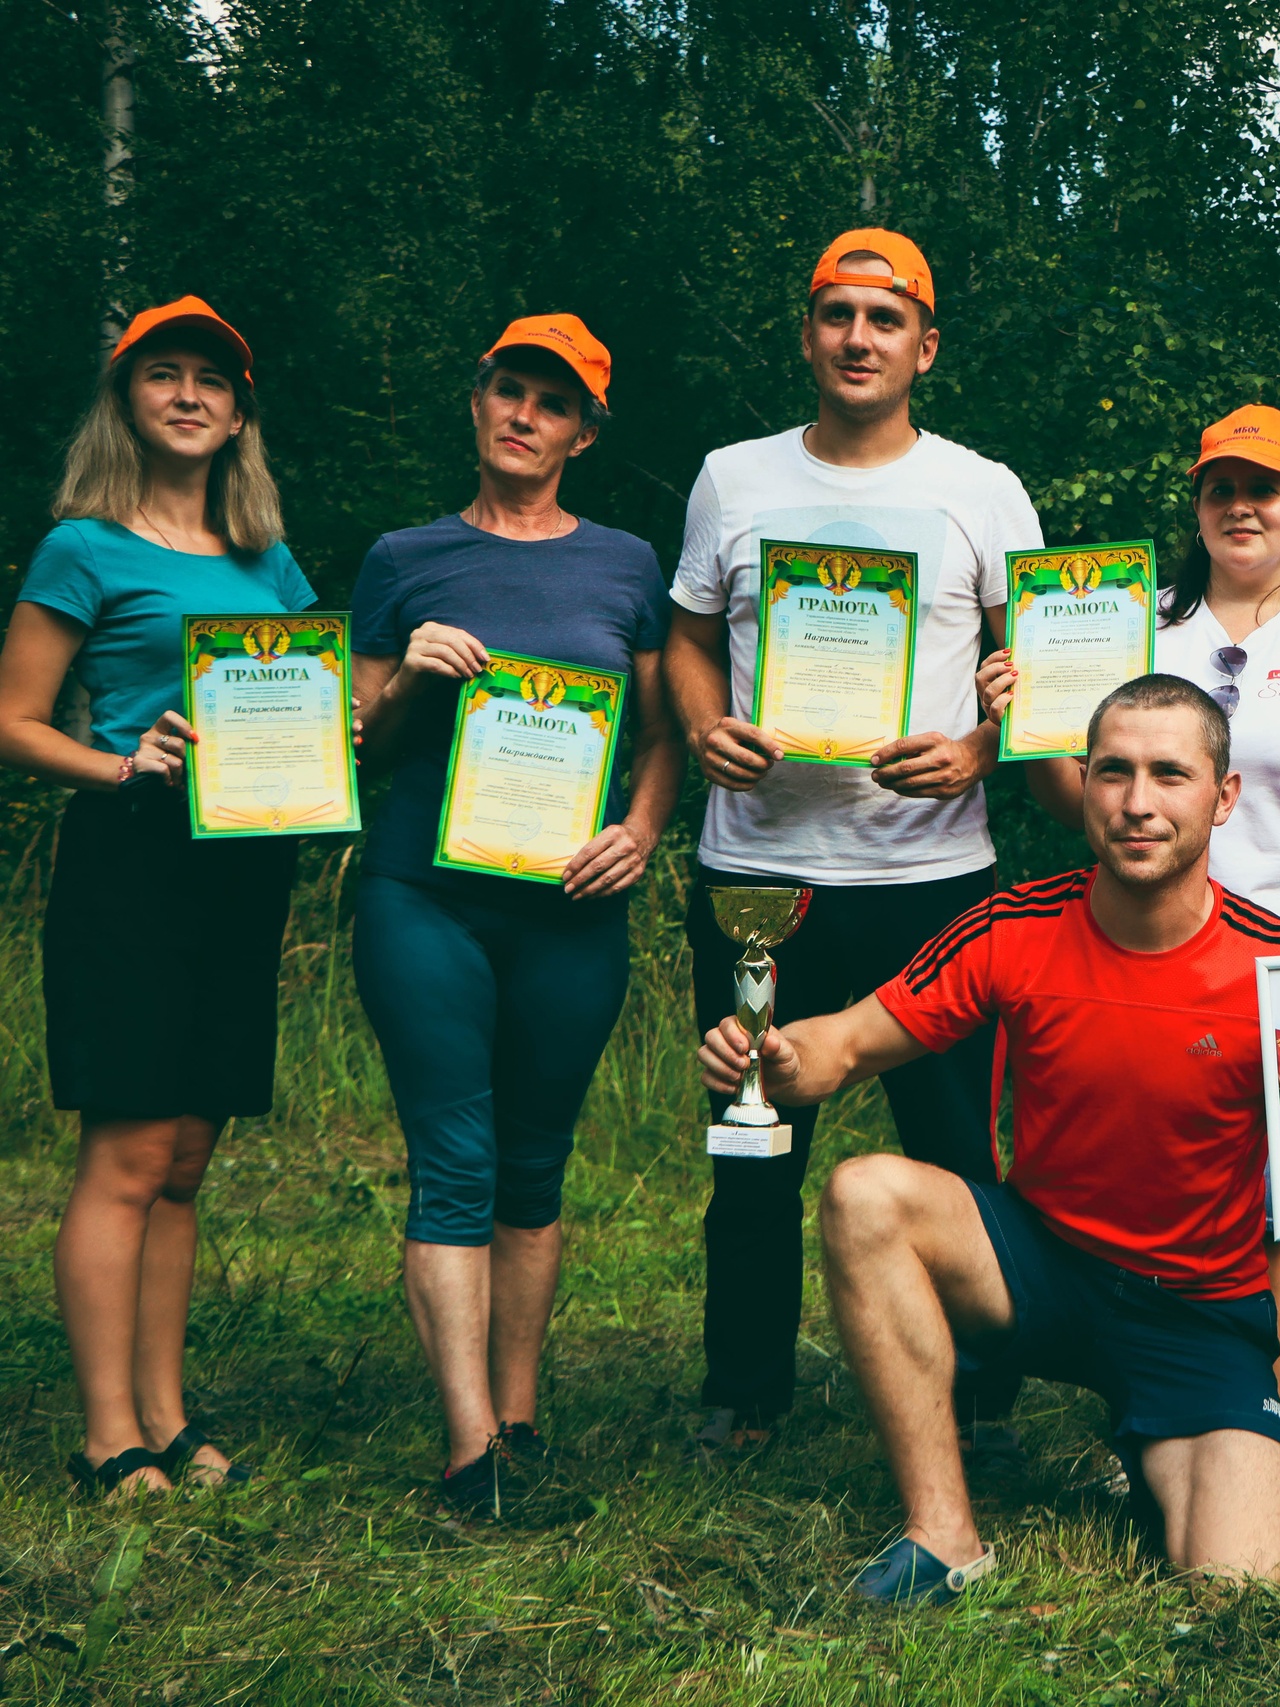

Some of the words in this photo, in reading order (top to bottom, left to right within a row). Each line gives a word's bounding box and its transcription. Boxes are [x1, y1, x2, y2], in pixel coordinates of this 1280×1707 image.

[1233, 426, 1260, 434] МБОУ
[798, 597, 879, 617] ГРАМОТА
[1043, 600, 1120, 619] ГРАМОТА
[804, 632, 869, 647] Награждается
[1048, 636, 1112, 646] Награждается
[224, 667, 311, 683] ГРАМОТА
[233, 704, 303, 715] Награждается
[496, 709, 578, 736] ГРАМОТА
[498, 745, 565, 763] Награждается
[1186, 1047, 1222, 1058] adidas
